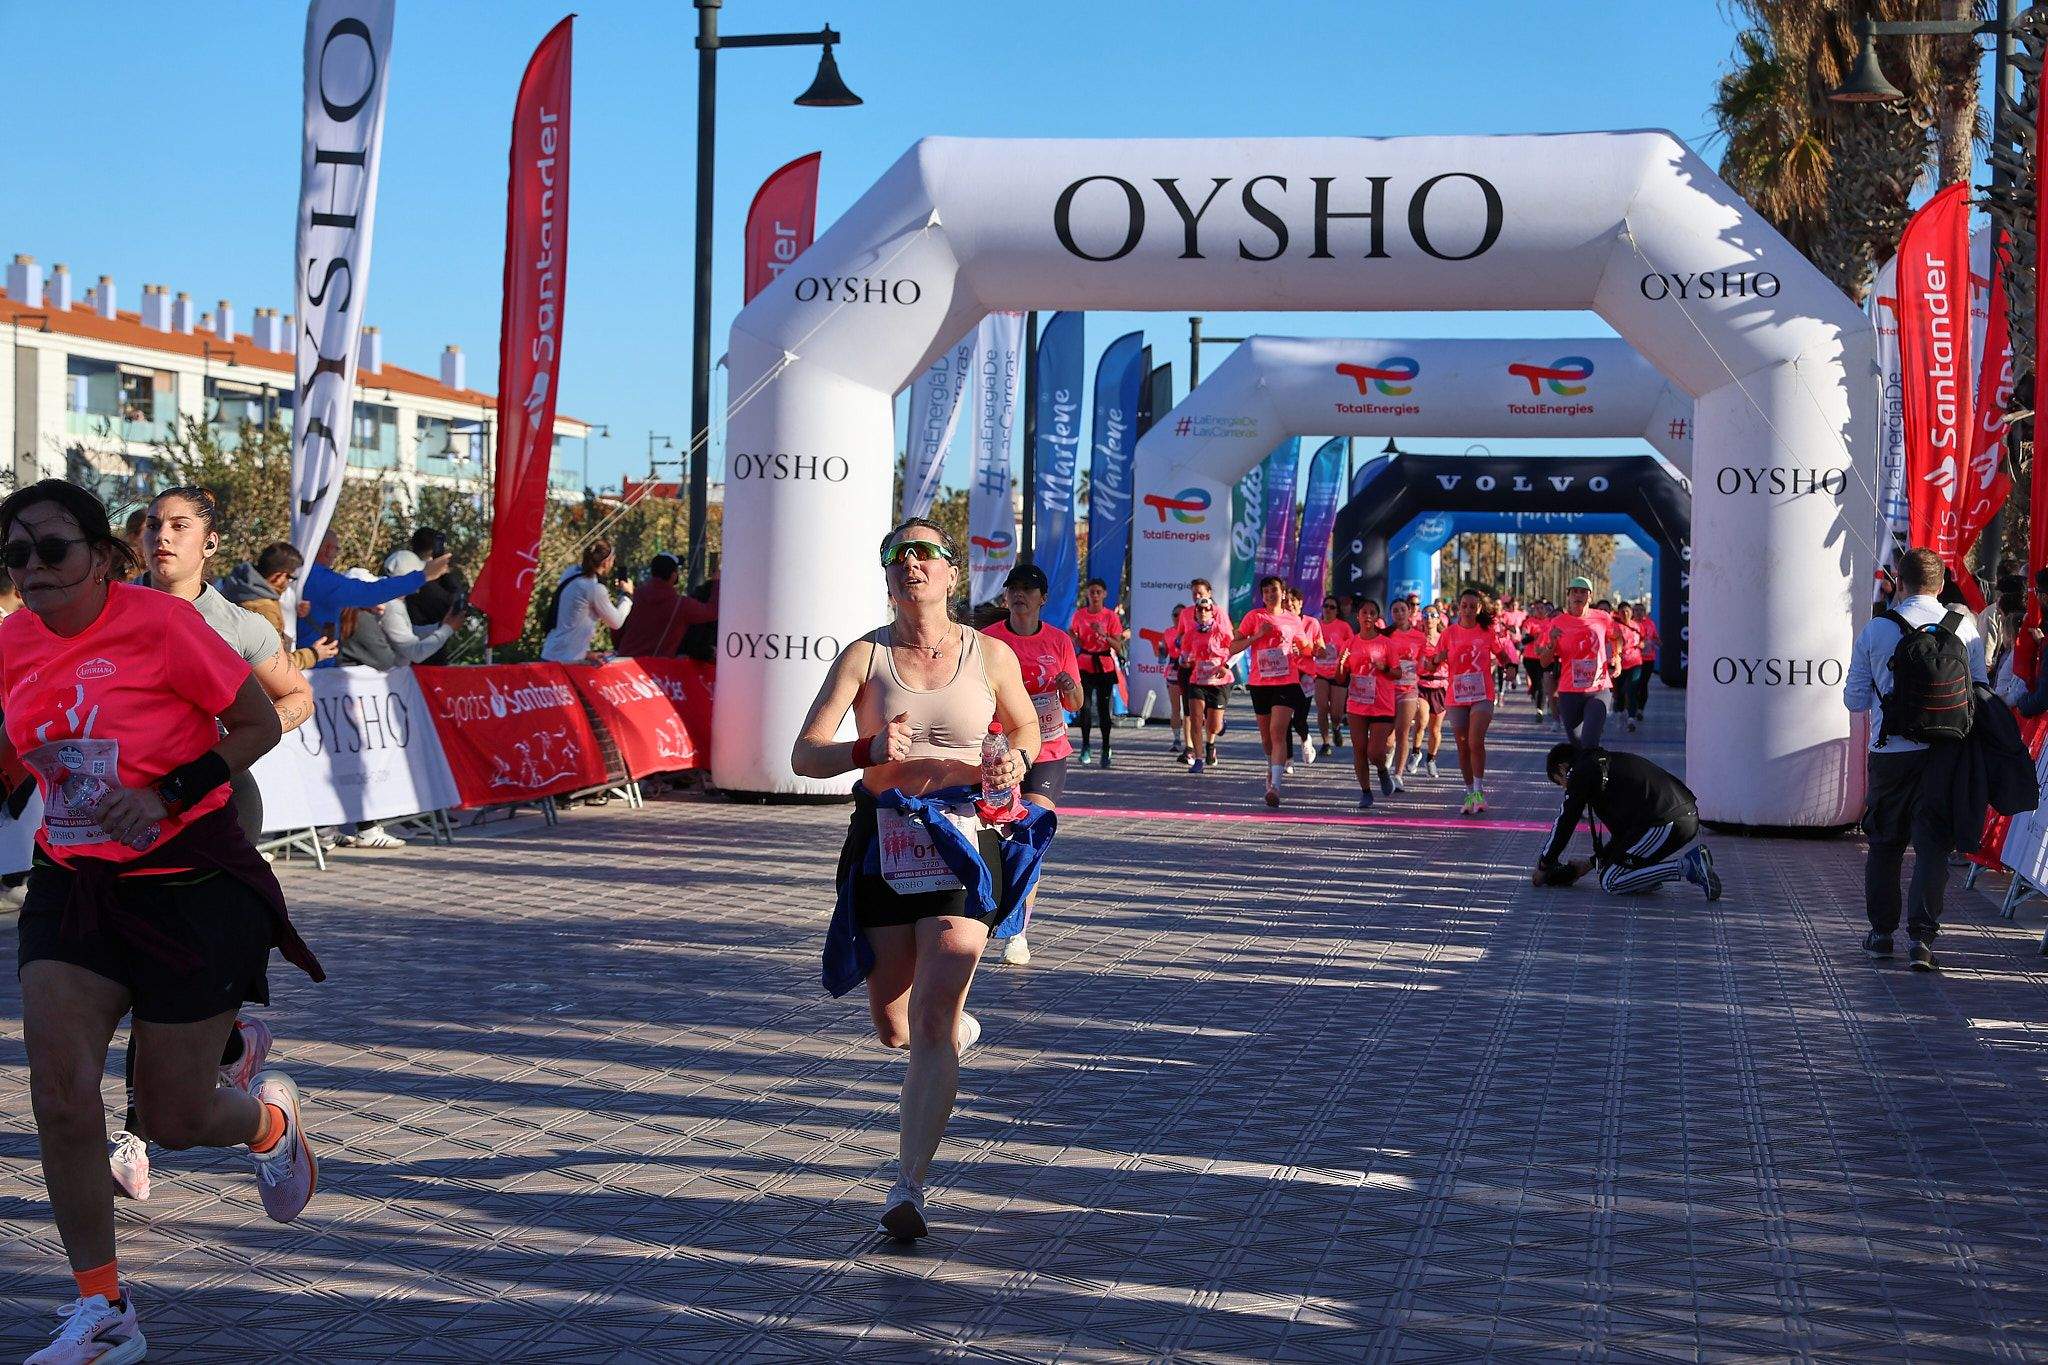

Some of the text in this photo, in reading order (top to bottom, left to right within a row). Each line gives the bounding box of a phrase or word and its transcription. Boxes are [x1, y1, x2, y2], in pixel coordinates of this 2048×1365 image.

[1053, 171, 1504, 262] OYSHO
[532, 105, 559, 363] Santander
[795, 276, 922, 305] OYSHO
[1640, 271, 1781, 301] OYSHO
[1924, 251, 1957, 450] Santander
[1334, 403, 1421, 416] TotalEnergies
[1508, 403, 1595, 416] TotalEnergies
[1039, 388, 1079, 513] Marlene
[1094, 408, 1132, 522] Marlene
[734, 453, 850, 483] OYSHO
[1716, 466, 1847, 496] OYSHO
[1436, 474, 1610, 493] VOLVO
[1143, 530, 1211, 543] TotalEnergies
[726, 631, 840, 662] OYSHO
[1713, 656, 1844, 687] OYSHO
[298, 691, 410, 757] OYSHO
[1039, 713, 1053, 723] 16
[894, 881, 924, 889] OYSHO
